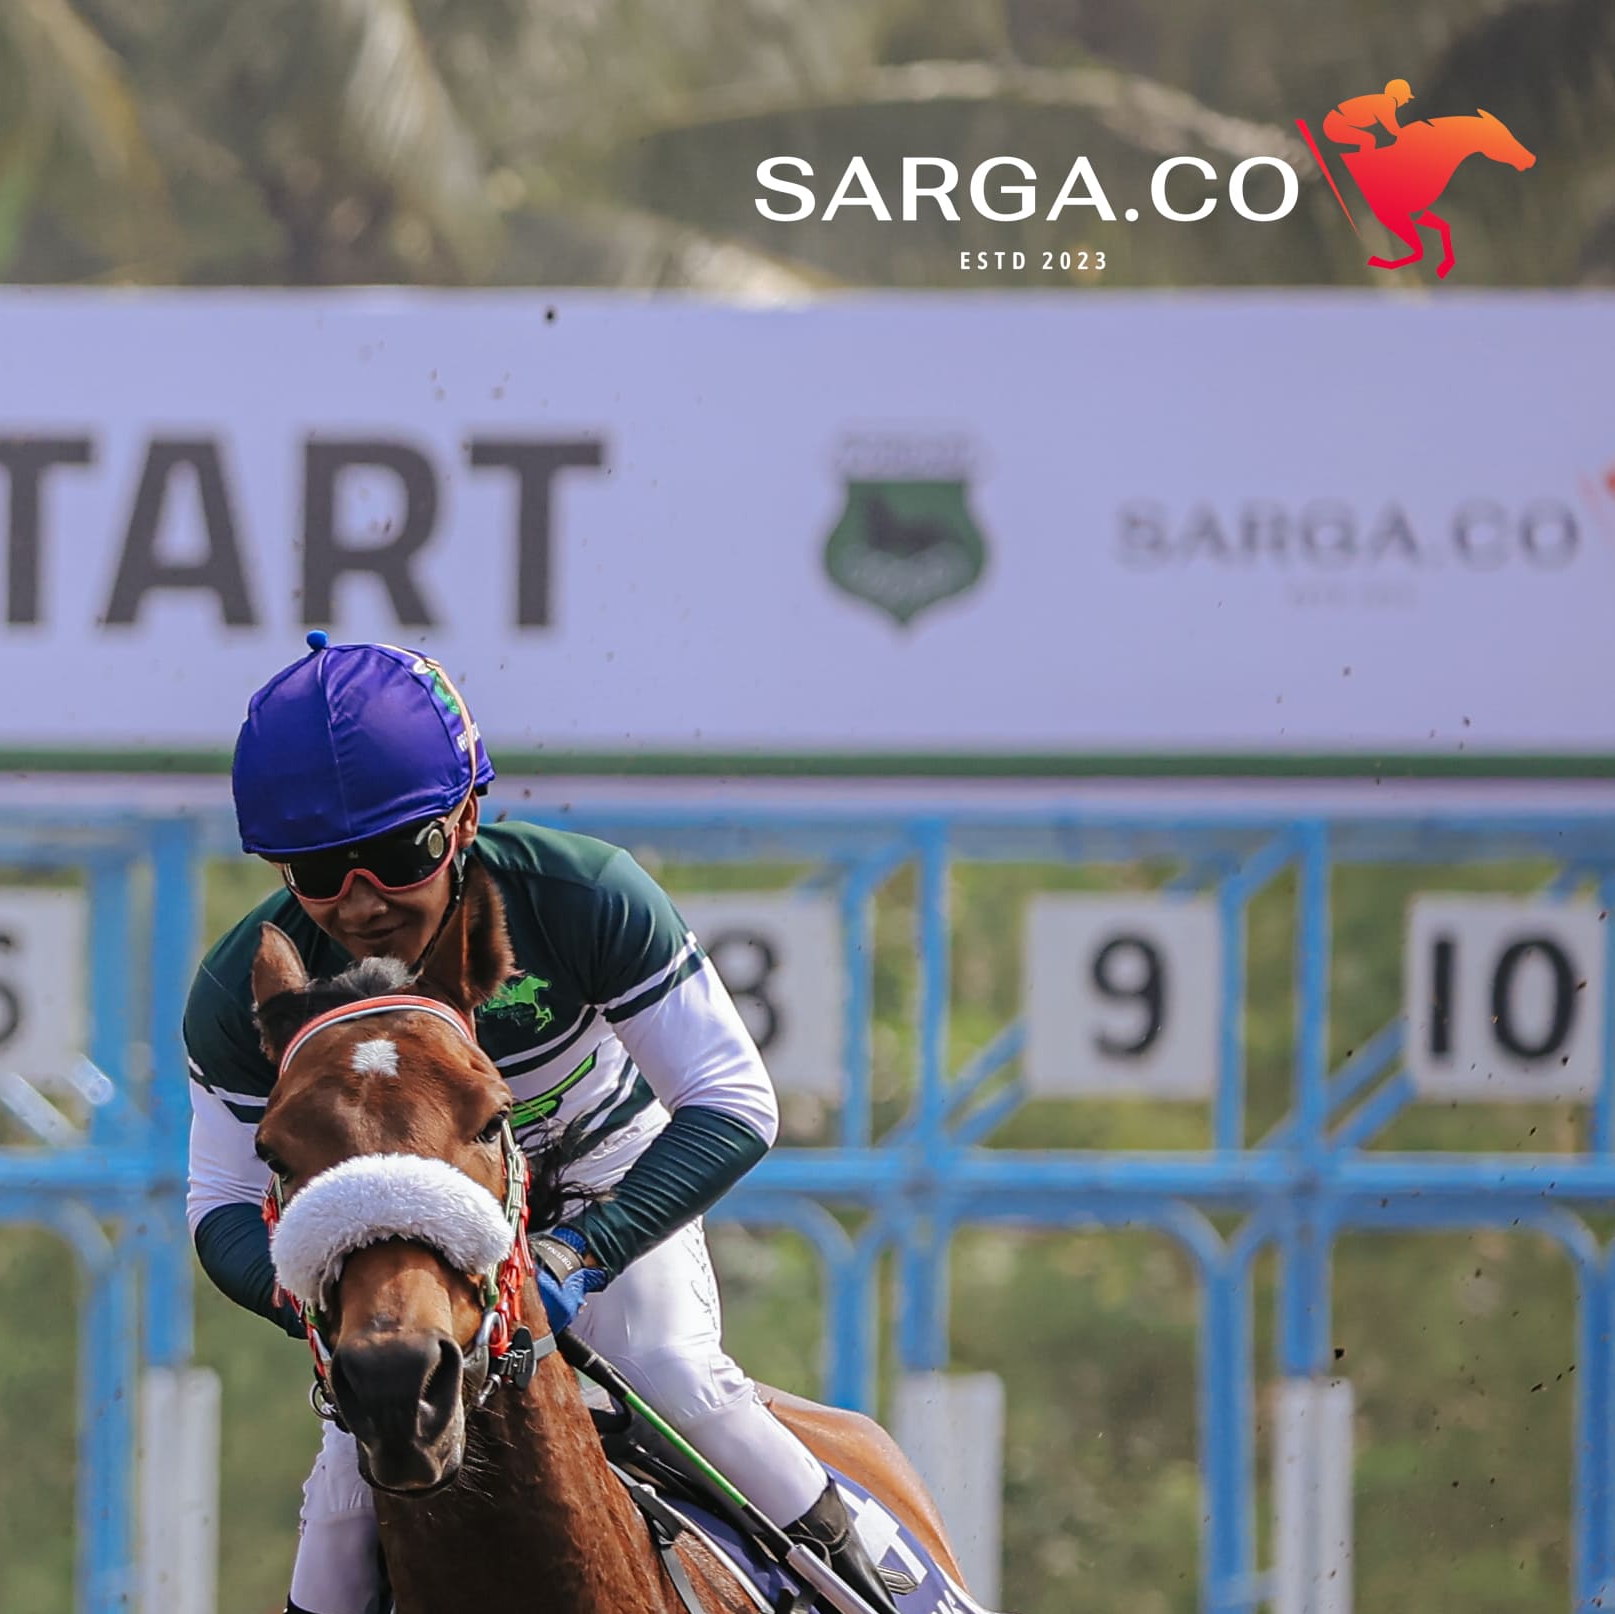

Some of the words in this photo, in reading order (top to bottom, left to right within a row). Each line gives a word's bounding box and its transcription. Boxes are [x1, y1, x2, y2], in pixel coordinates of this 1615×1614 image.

[706, 930, 781, 1054] 8
[1090, 933, 1169, 1061] 9
[1427, 932, 1587, 1067] 10
